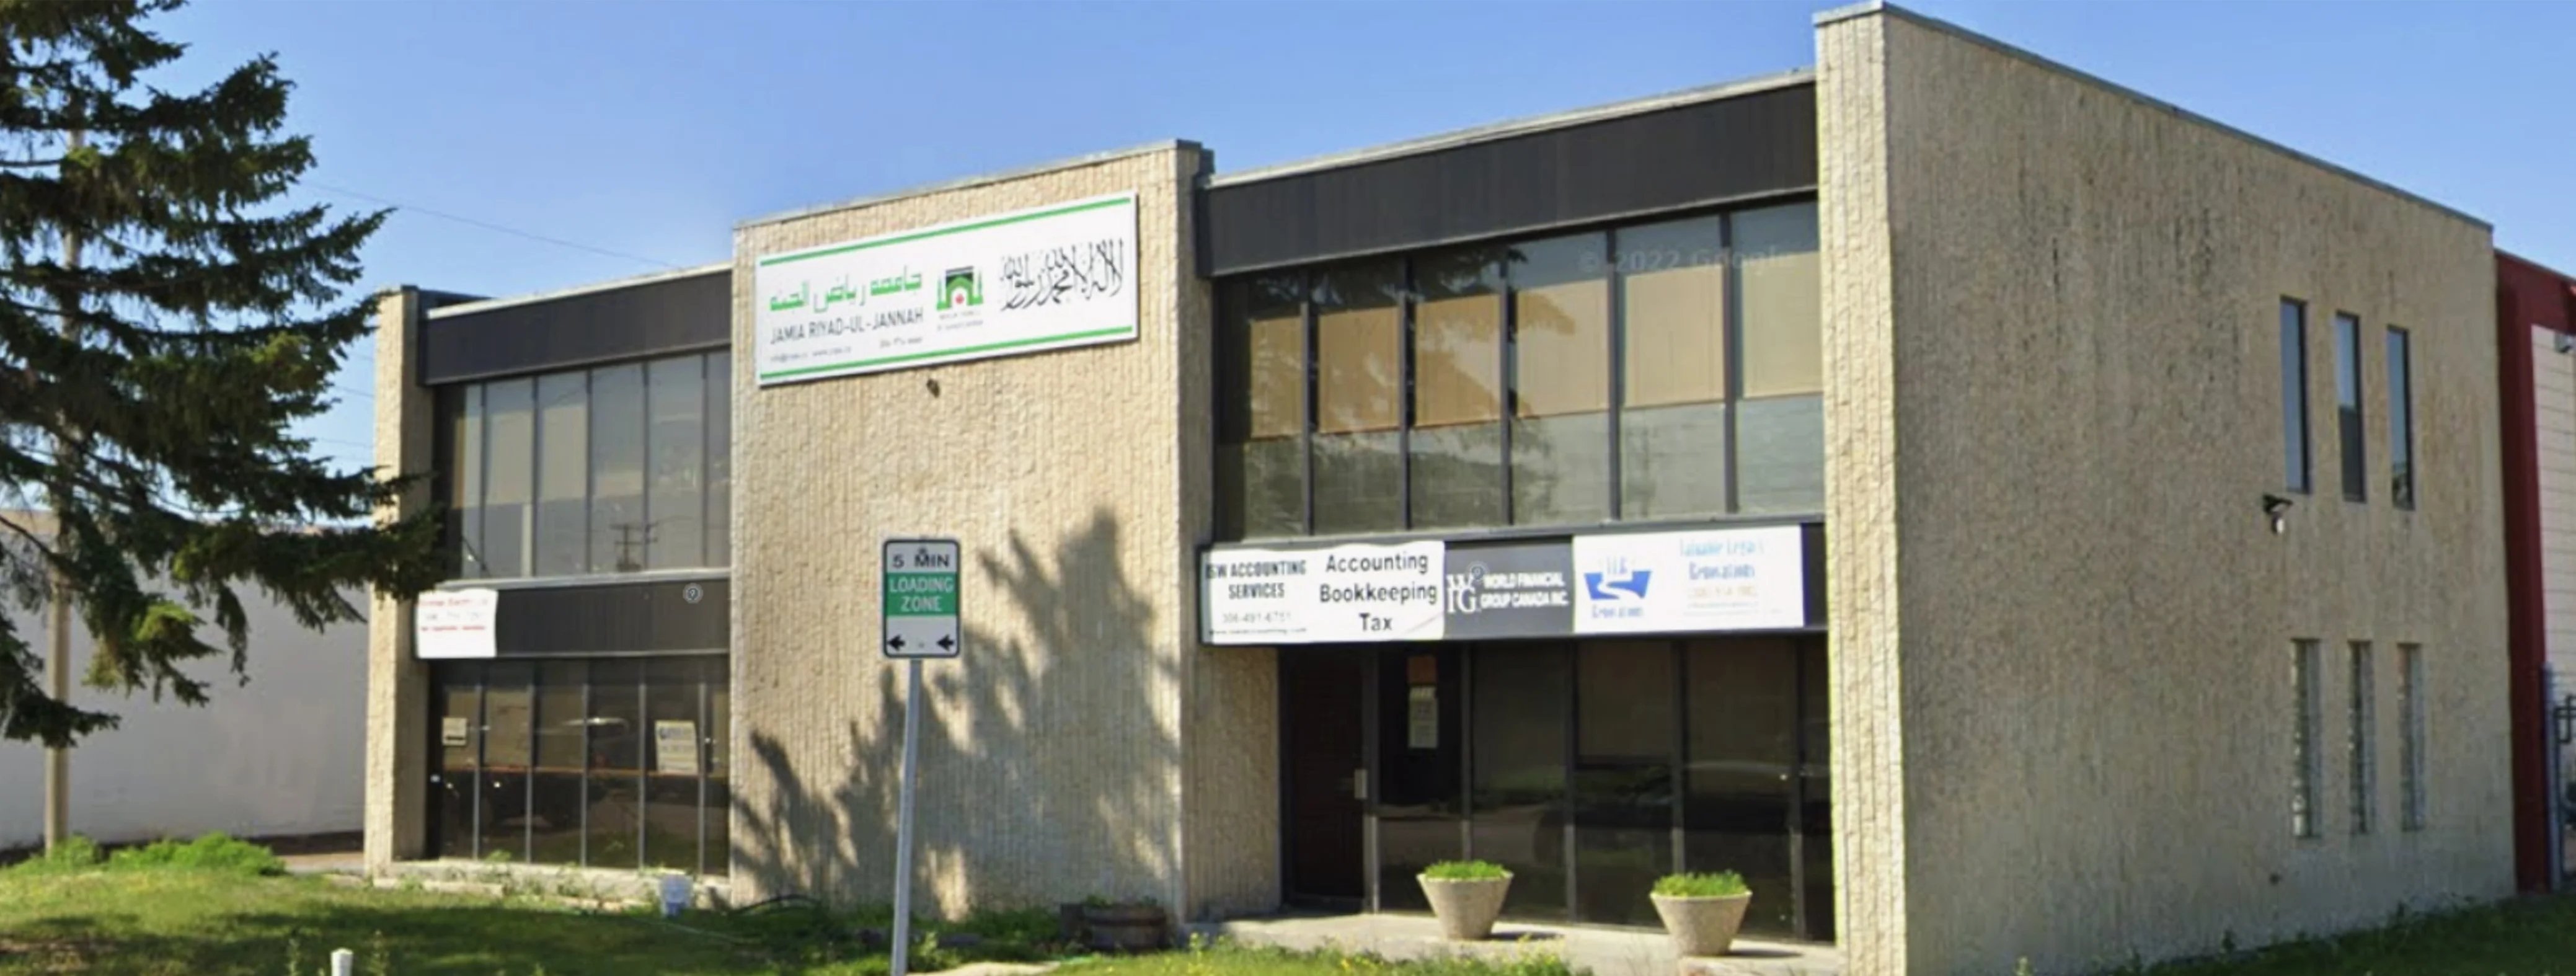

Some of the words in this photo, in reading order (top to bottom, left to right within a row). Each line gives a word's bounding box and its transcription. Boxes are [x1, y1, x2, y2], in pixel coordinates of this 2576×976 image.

[770, 323, 805, 345] JAMIA
[808, 306, 923, 338] RIYAD-UL-JANNAH
[892, 554, 905, 569] 5
[914, 554, 950, 568] MIN
[1231, 560, 1306, 578] ACCOUNTING
[1326, 551, 1428, 575] Accounting
[888, 575, 954, 593] LOADING
[1482, 573, 1516, 589] WORLD
[1517, 572, 1566, 588] FINANCIAL
[1228, 582, 1285, 600] SERVICES
[1319, 581, 1437, 605] Bookkeeping
[1479, 592, 1512, 609] GROUP
[1512, 591, 1550, 608] CANADA
[900, 596, 942, 612] ZONE
[1358, 612, 1392, 631] Tax
